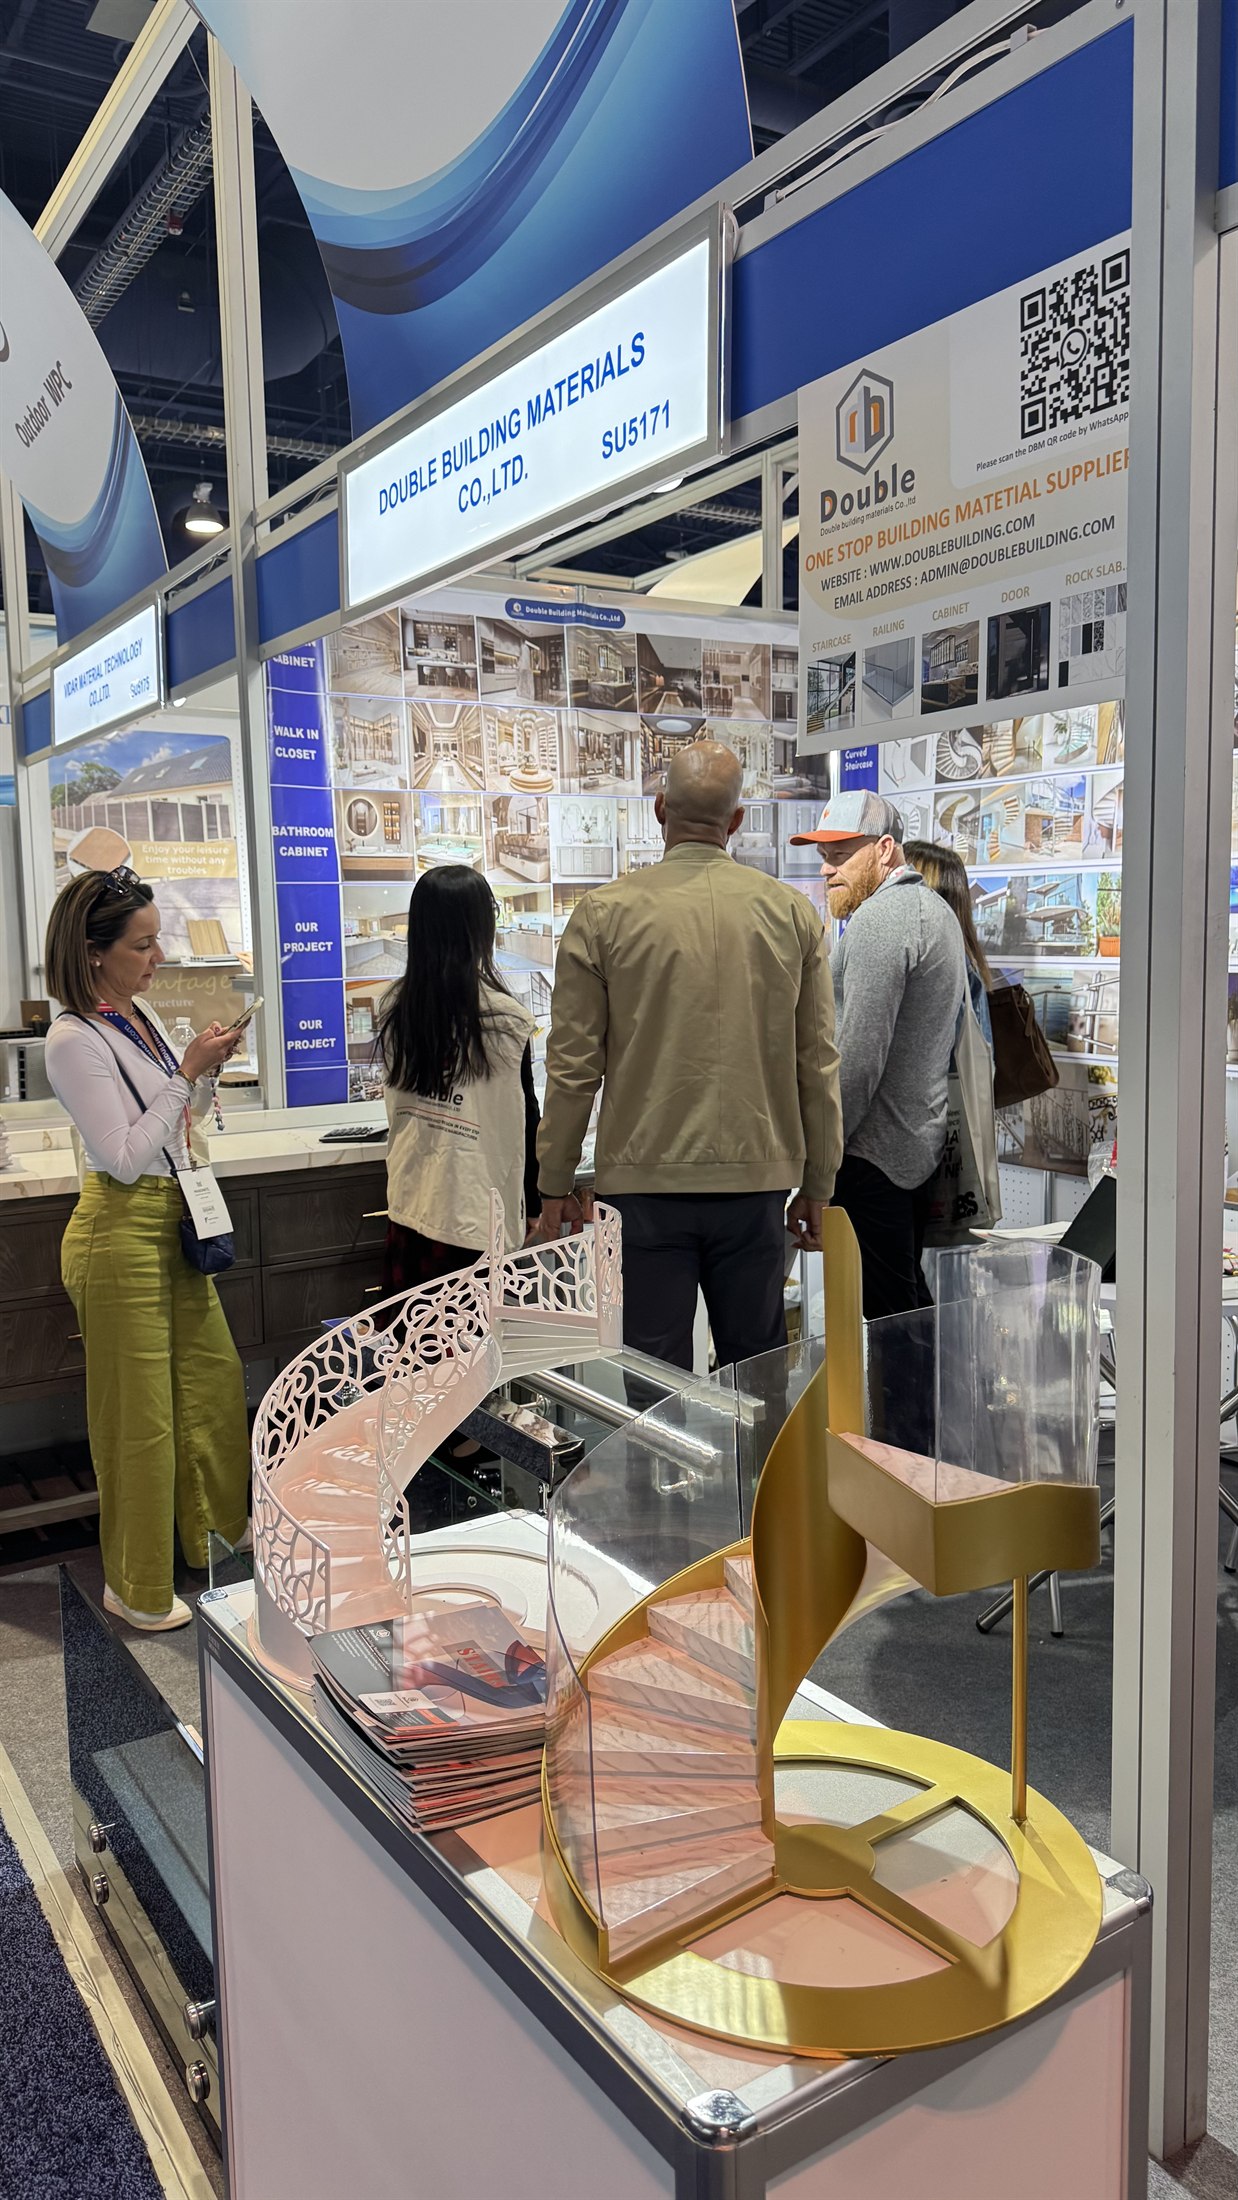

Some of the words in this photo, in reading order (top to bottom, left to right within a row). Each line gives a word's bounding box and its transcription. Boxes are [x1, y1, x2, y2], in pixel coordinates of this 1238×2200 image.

[15, 395, 52, 448] Outdoor
[43, 360, 72, 407] WPC
[379, 458, 437, 515] DOUBLE
[442, 408, 521, 480] BUILDING
[527, 332, 645, 431] MATERIALS
[976, 458, 998, 472] Please
[998, 452, 1014, 464] scan
[1015, 446, 1027, 459] the
[1028, 441, 1046, 454] DBM
[1047, 435, 1058, 447] QR
[1059, 430, 1077, 443] code
[1078, 424, 1088, 437] by
[1089, 411, 1129, 431] WhatsApp
[458, 454, 528, 513] CO.,LTD.
[602, 399, 670, 460] SU5171
[820, 462, 915, 524] Double
[805, 547, 834, 573] ONE
[837, 534, 873, 563] STOP
[877, 508, 950, 549] BUILDING
[955, 478, 1041, 524] MATETIAL
[820, 523, 840, 537] Double
[841, 515, 865, 530] building
[865, 504, 894, 521] materials
[820, 568, 862, 592] WEBSITE
[869, 513, 1035, 577] WWW.DOUBLEBUILDING.COM
[834, 590, 864, 610] EMAIL
[866, 575, 912, 601] ADDRESS
[920, 515, 1115, 585] ADMIN@DOUBLEBUILDING.COM
[1065, 568, 1094, 586] ROCK
[1001, 586, 1030, 603] DOOR
[525, 605, 547, 615] Double
[548, 608, 576, 618] Building
[932, 602, 970, 621] CABINET
[872, 619, 905, 637] RAILING
[812, 633, 851, 653] STAIRCASE
[79, 663, 103, 689] MATERIAL
[104, 637, 143, 675] TECHNOLOGY
[273, 725, 304, 739] WALK
[307, 729, 319, 740] IN
[275, 747, 317, 760] CLOSET
[845, 747, 868, 759] Curved
[845, 760, 873, 771] Staircase
[272, 826, 334, 838] BATHROOM
[142, 844, 169, 855] Enjoy
[172, 846, 195, 856] your
[196, 845, 229, 855] leisure
[279, 846, 329, 857] CABINET
[145, 855, 169, 864] time
[171, 855, 207, 864] without
[209, 857, 226, 867] any
[167, 866, 208, 875] troubles
[295, 922, 318, 932] OUR
[283, 941, 333, 953] PROJECT
[299, 1019, 322, 1030] OUR
[287, 1037, 336, 1051] PROJECT
